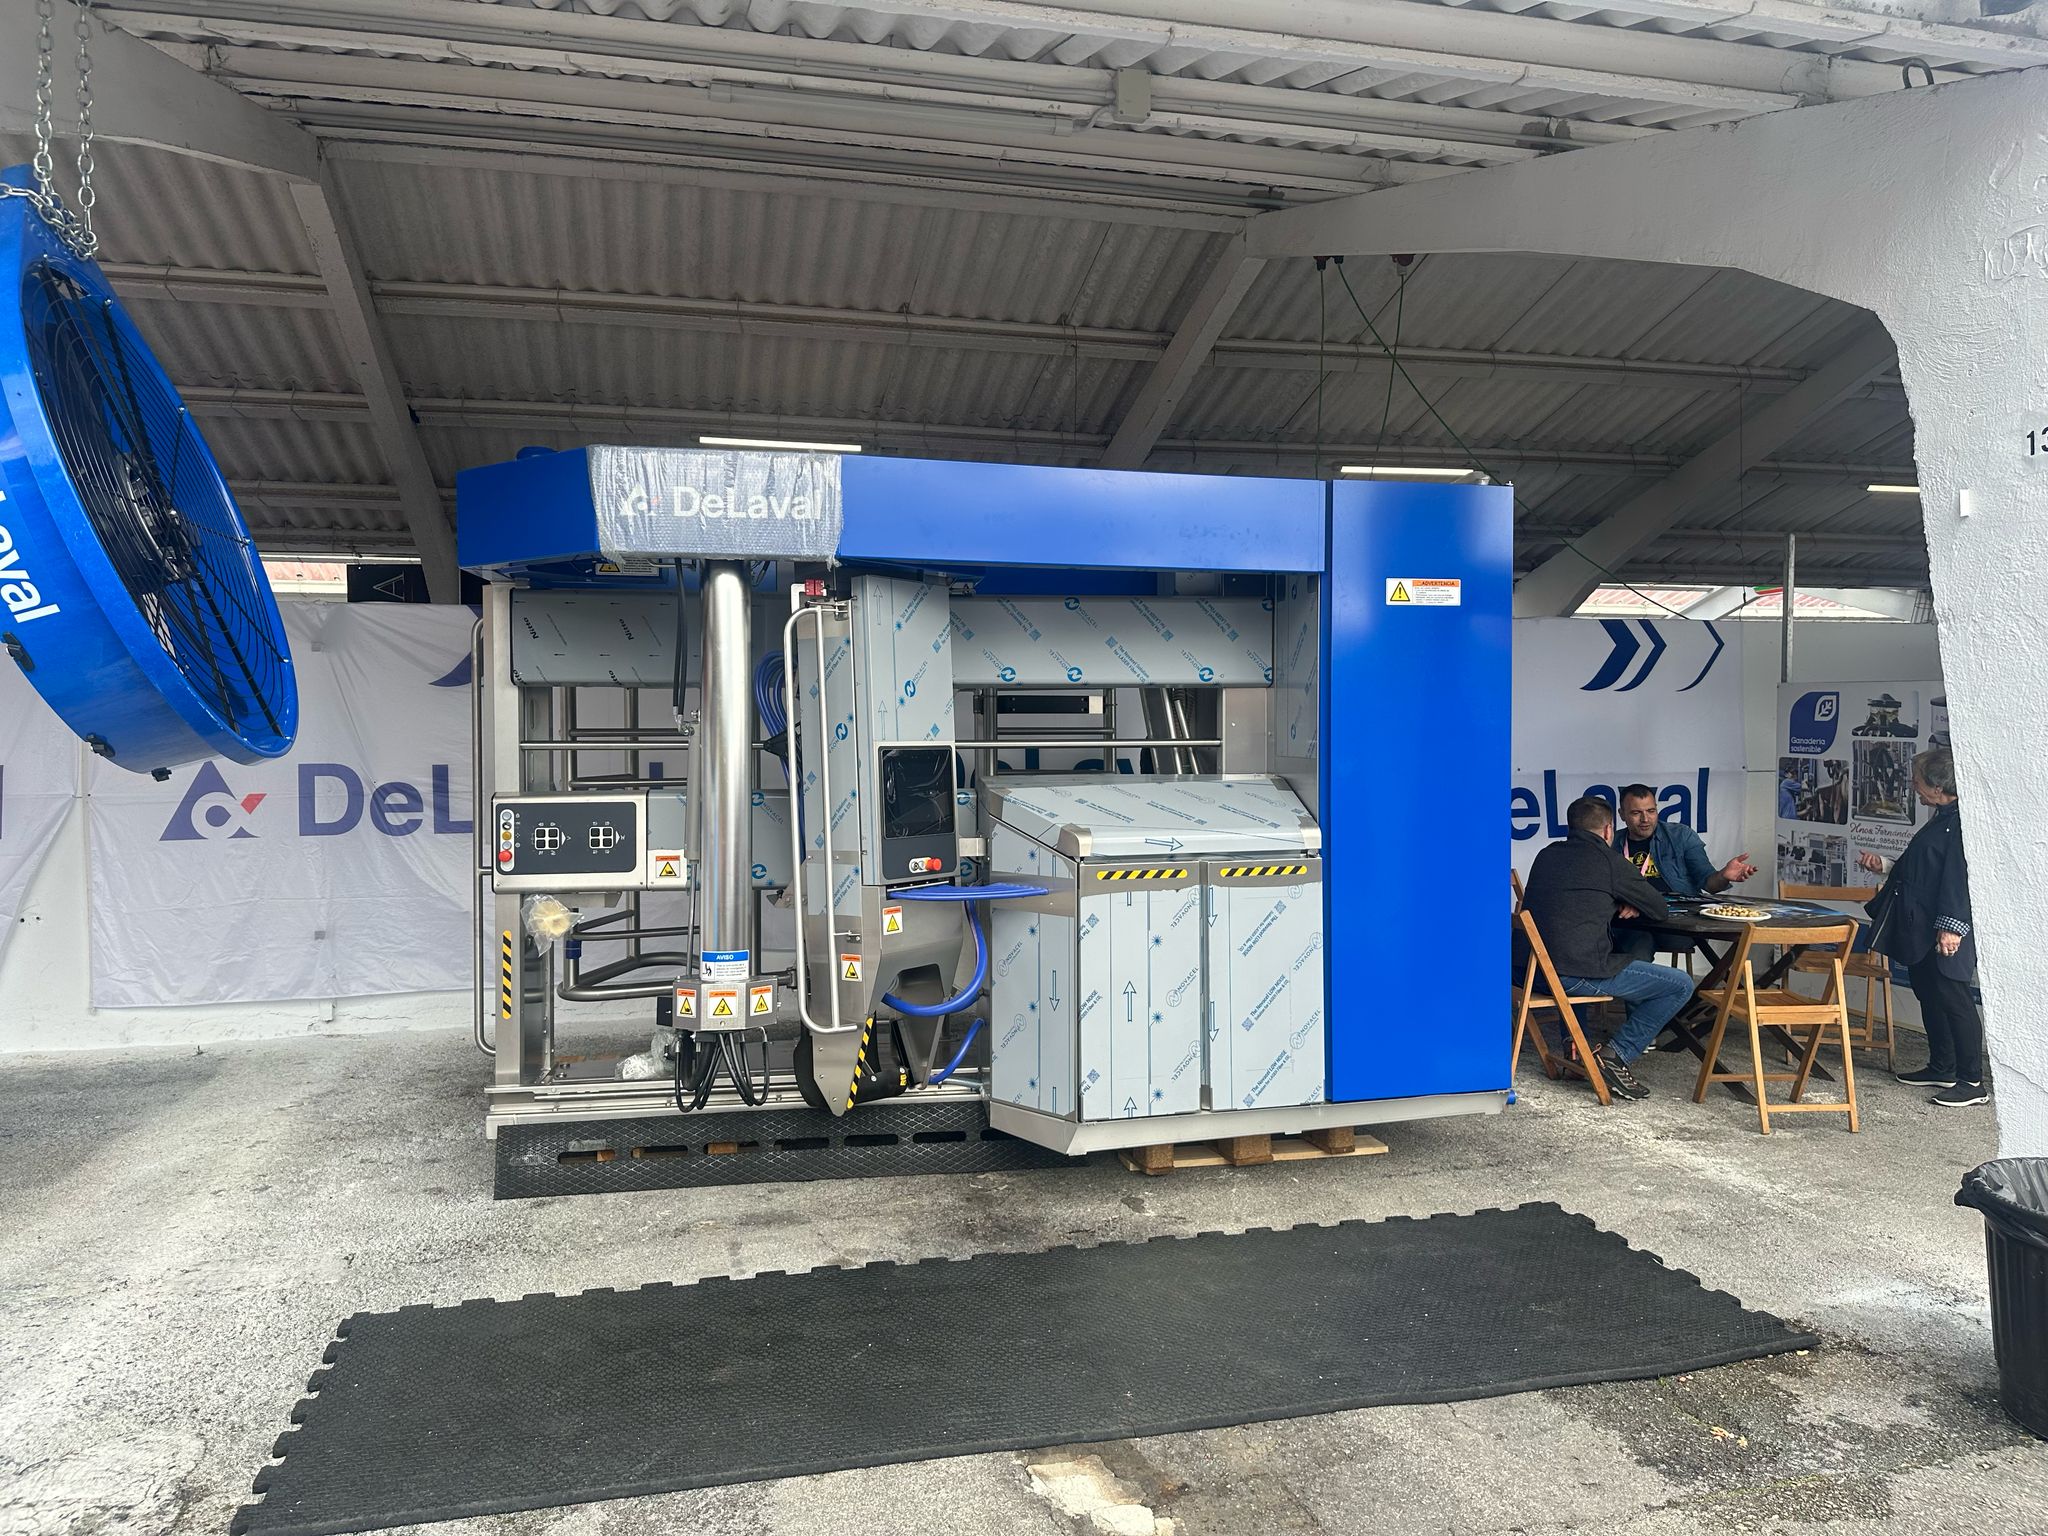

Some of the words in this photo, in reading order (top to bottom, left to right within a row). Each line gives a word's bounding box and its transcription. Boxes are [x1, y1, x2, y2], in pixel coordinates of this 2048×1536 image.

[673, 486, 822, 519] DeLaval
[0, 491, 60, 623] aval
[524, 618, 539, 639] Nitto
[620, 619, 634, 640] Nitto
[983, 649, 1002, 670] NOVACEL
[1049, 649, 1069, 671] NOVACEL
[1181, 650, 1200, 671] NOVACEL
[1247, 650, 1265, 671] NOVACEL
[1171, 904, 1192, 927] NOVACEL
[1006, 941, 1022, 961] NOVACEL
[1293, 948, 1313, 971] NOVACEL
[1177, 968, 1198, 991] NOVACEL
[1300, 1010, 1320, 1033] NOVACEL
[1001, 1029, 1017, 1048] NOVACEL
[1171, 1056, 1193, 1080] NOVACEL
